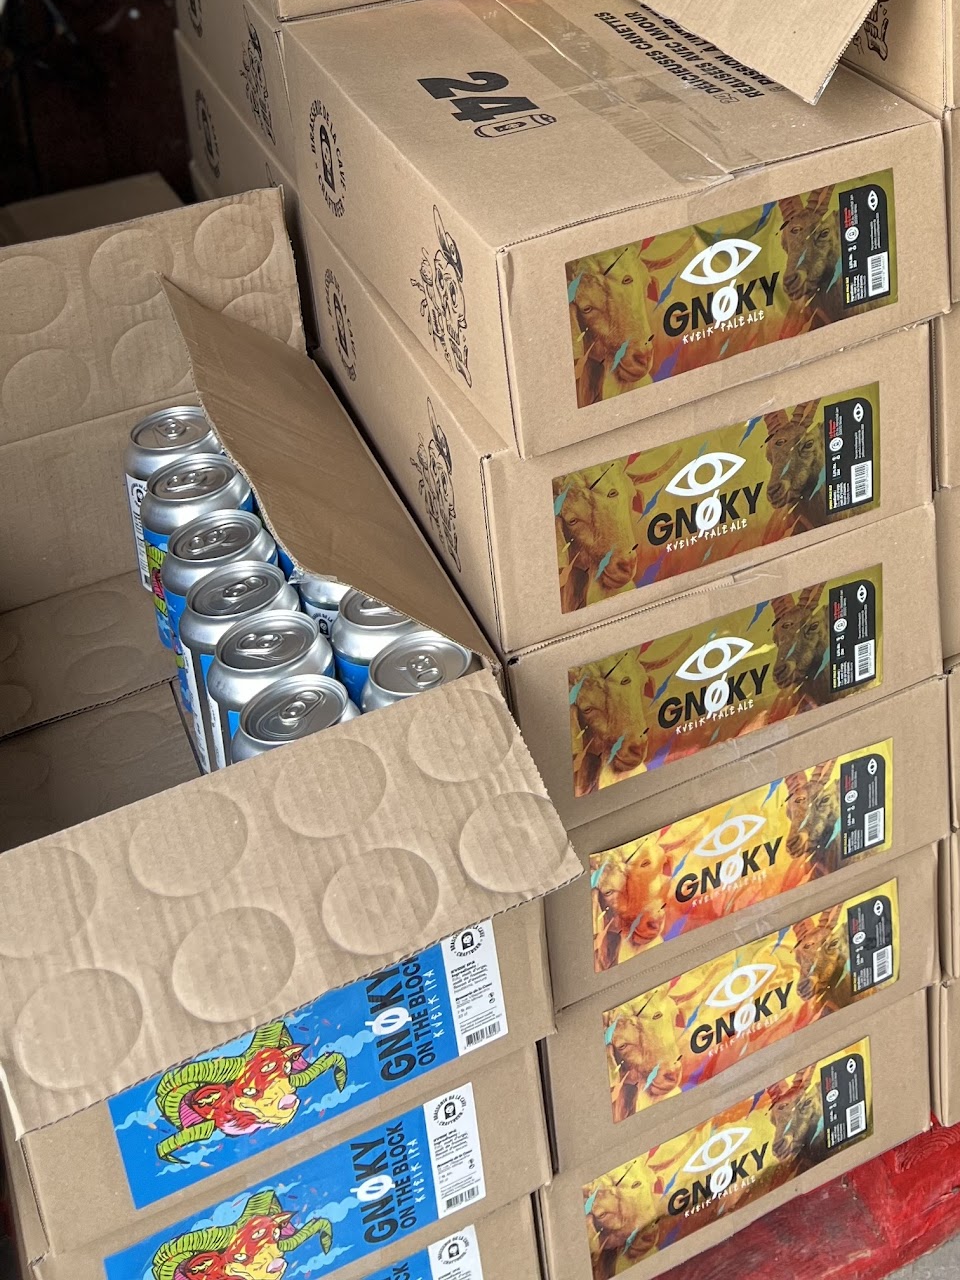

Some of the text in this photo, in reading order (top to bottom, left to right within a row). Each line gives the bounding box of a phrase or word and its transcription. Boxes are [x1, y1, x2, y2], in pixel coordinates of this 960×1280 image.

[594, 11, 653, 50] CANETTES
[624, 11, 765, 98] RÉALISÉES AVEC AMOUR
[645, 50, 724, 94] DÉLICIEUSES
[417, 71, 541, 123] 24
[721, 315, 745, 332] PALE
[747, 309, 764, 324] ALE
[704, 524, 728, 540] PALE
[730, 517, 747, 532] ALE
[712, 705, 735, 722] PALE
[737, 698, 754, 712] ALE
[423, 969, 445, 1039] KVEIK IPA
[411, 1008, 431, 1042] THE
[416, 1040, 436, 1066] ON
[386, 1121, 417, 1229] ON THE BLOCK
[406, 1138, 426, 1203] KVEIK IPA
[717, 1182, 738, 1200] PALE
[740, 1173, 756, 1188] ALE
